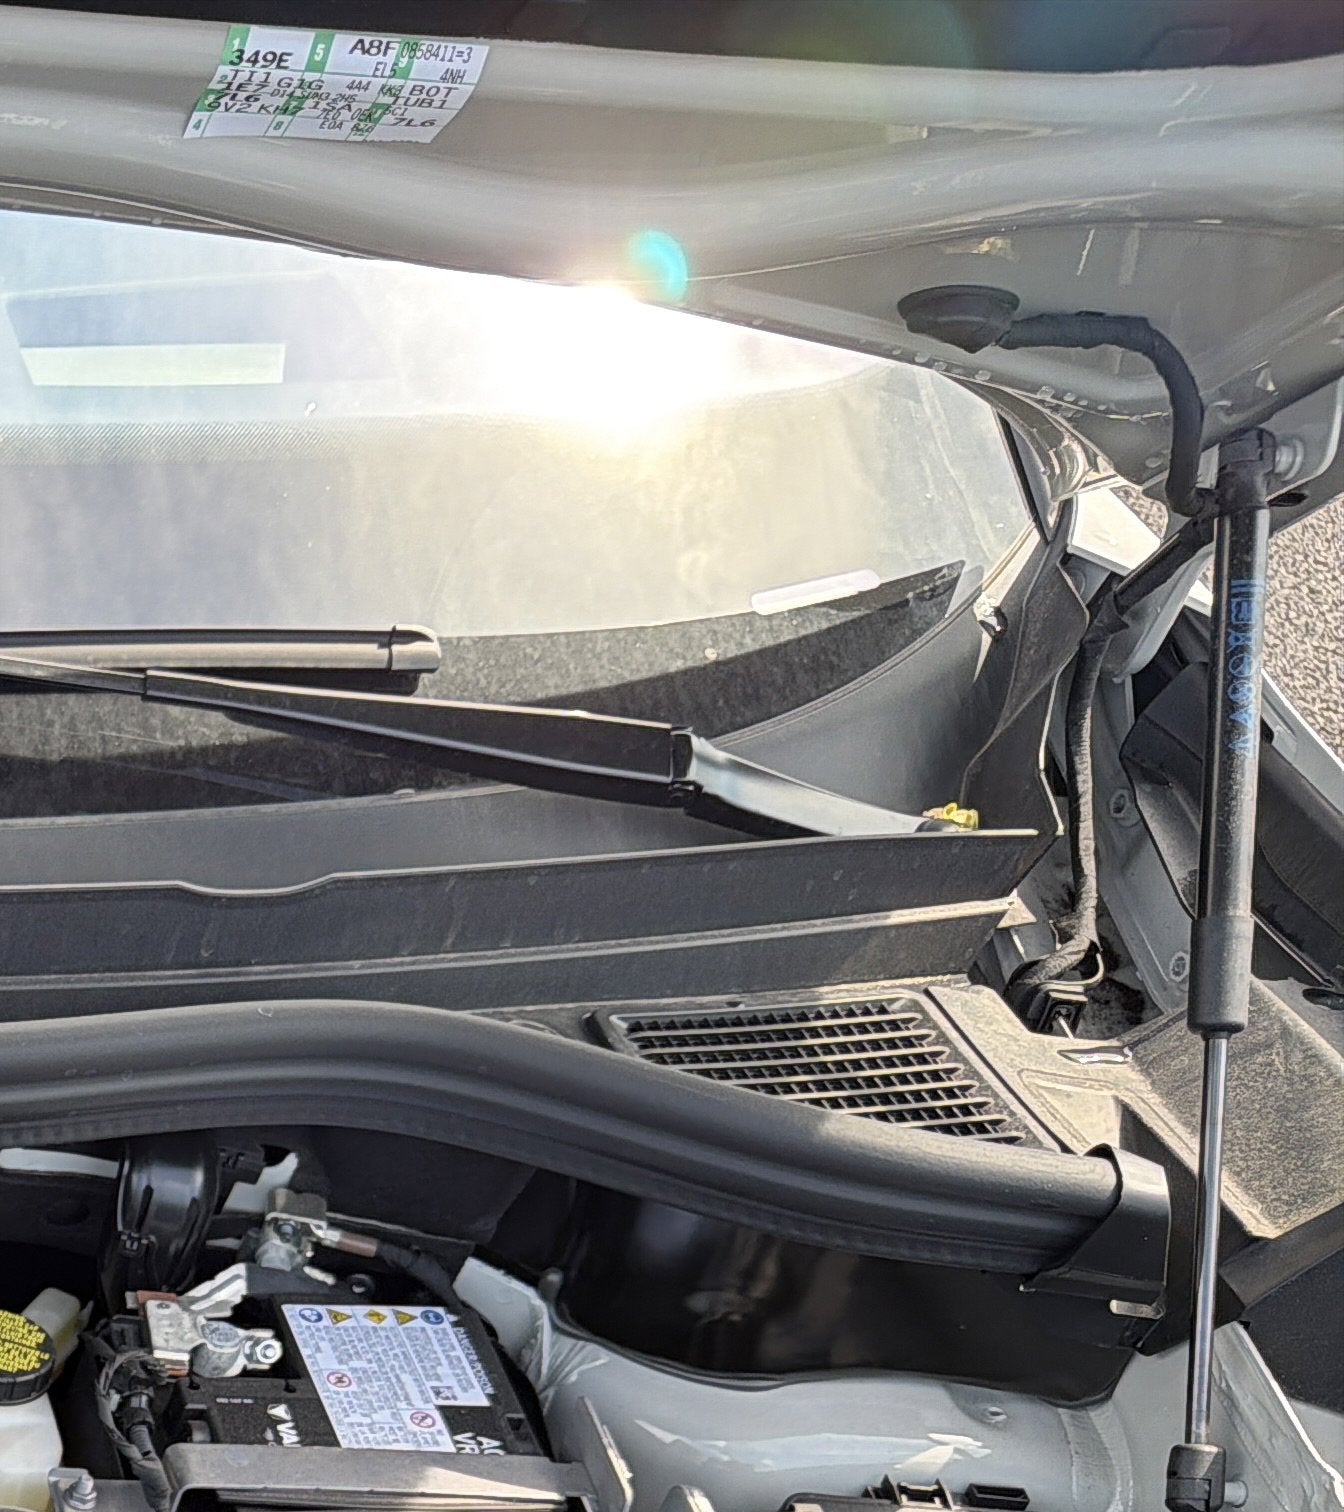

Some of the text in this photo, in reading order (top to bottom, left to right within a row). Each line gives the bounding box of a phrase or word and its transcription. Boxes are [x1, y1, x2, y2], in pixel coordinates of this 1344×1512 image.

[314, 44, 325, 61] 5
[349, 38, 400, 57] A8F
[229, 49, 293, 69] 349E
[440, 68, 466, 84] 4NH
[346, 80, 371, 91] 4A4
[193, 119, 202, 130] 4
